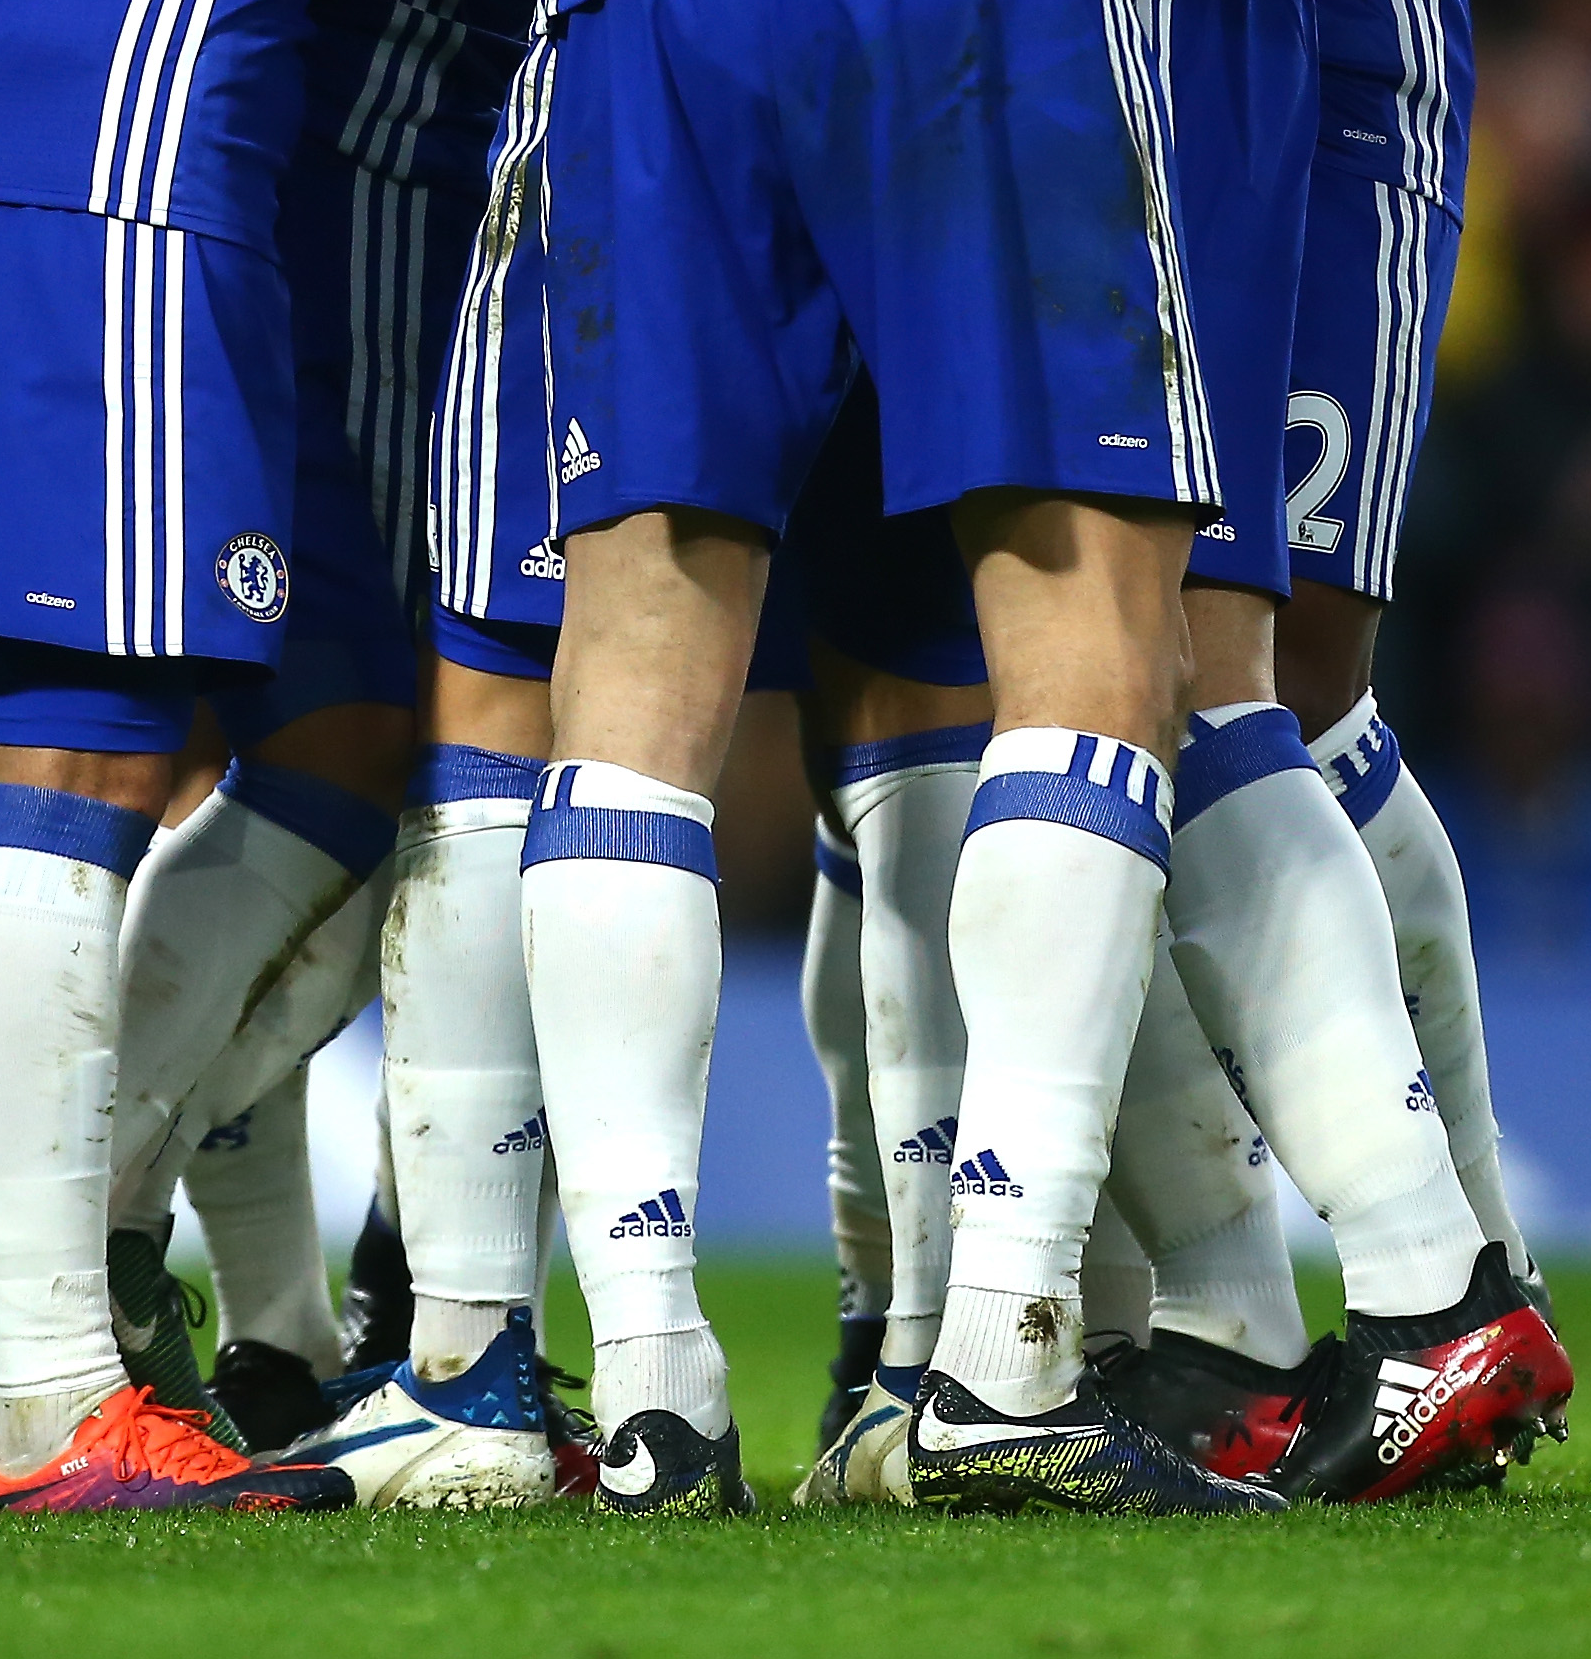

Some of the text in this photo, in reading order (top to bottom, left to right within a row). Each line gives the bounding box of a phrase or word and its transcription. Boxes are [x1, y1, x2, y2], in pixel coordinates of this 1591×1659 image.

[1343, 128, 1387, 145] adizero
[1098, 433, 1148, 449] adizero
[561, 452, 601, 484] adidas
[230, 536, 277, 560] CHELSEA
[26, 592, 75, 609] adizero
[610, 1220, 691, 1239] adidas
[1377, 1364, 1470, 1465] adidas
[60, 1456, 89, 1477] KYLE
